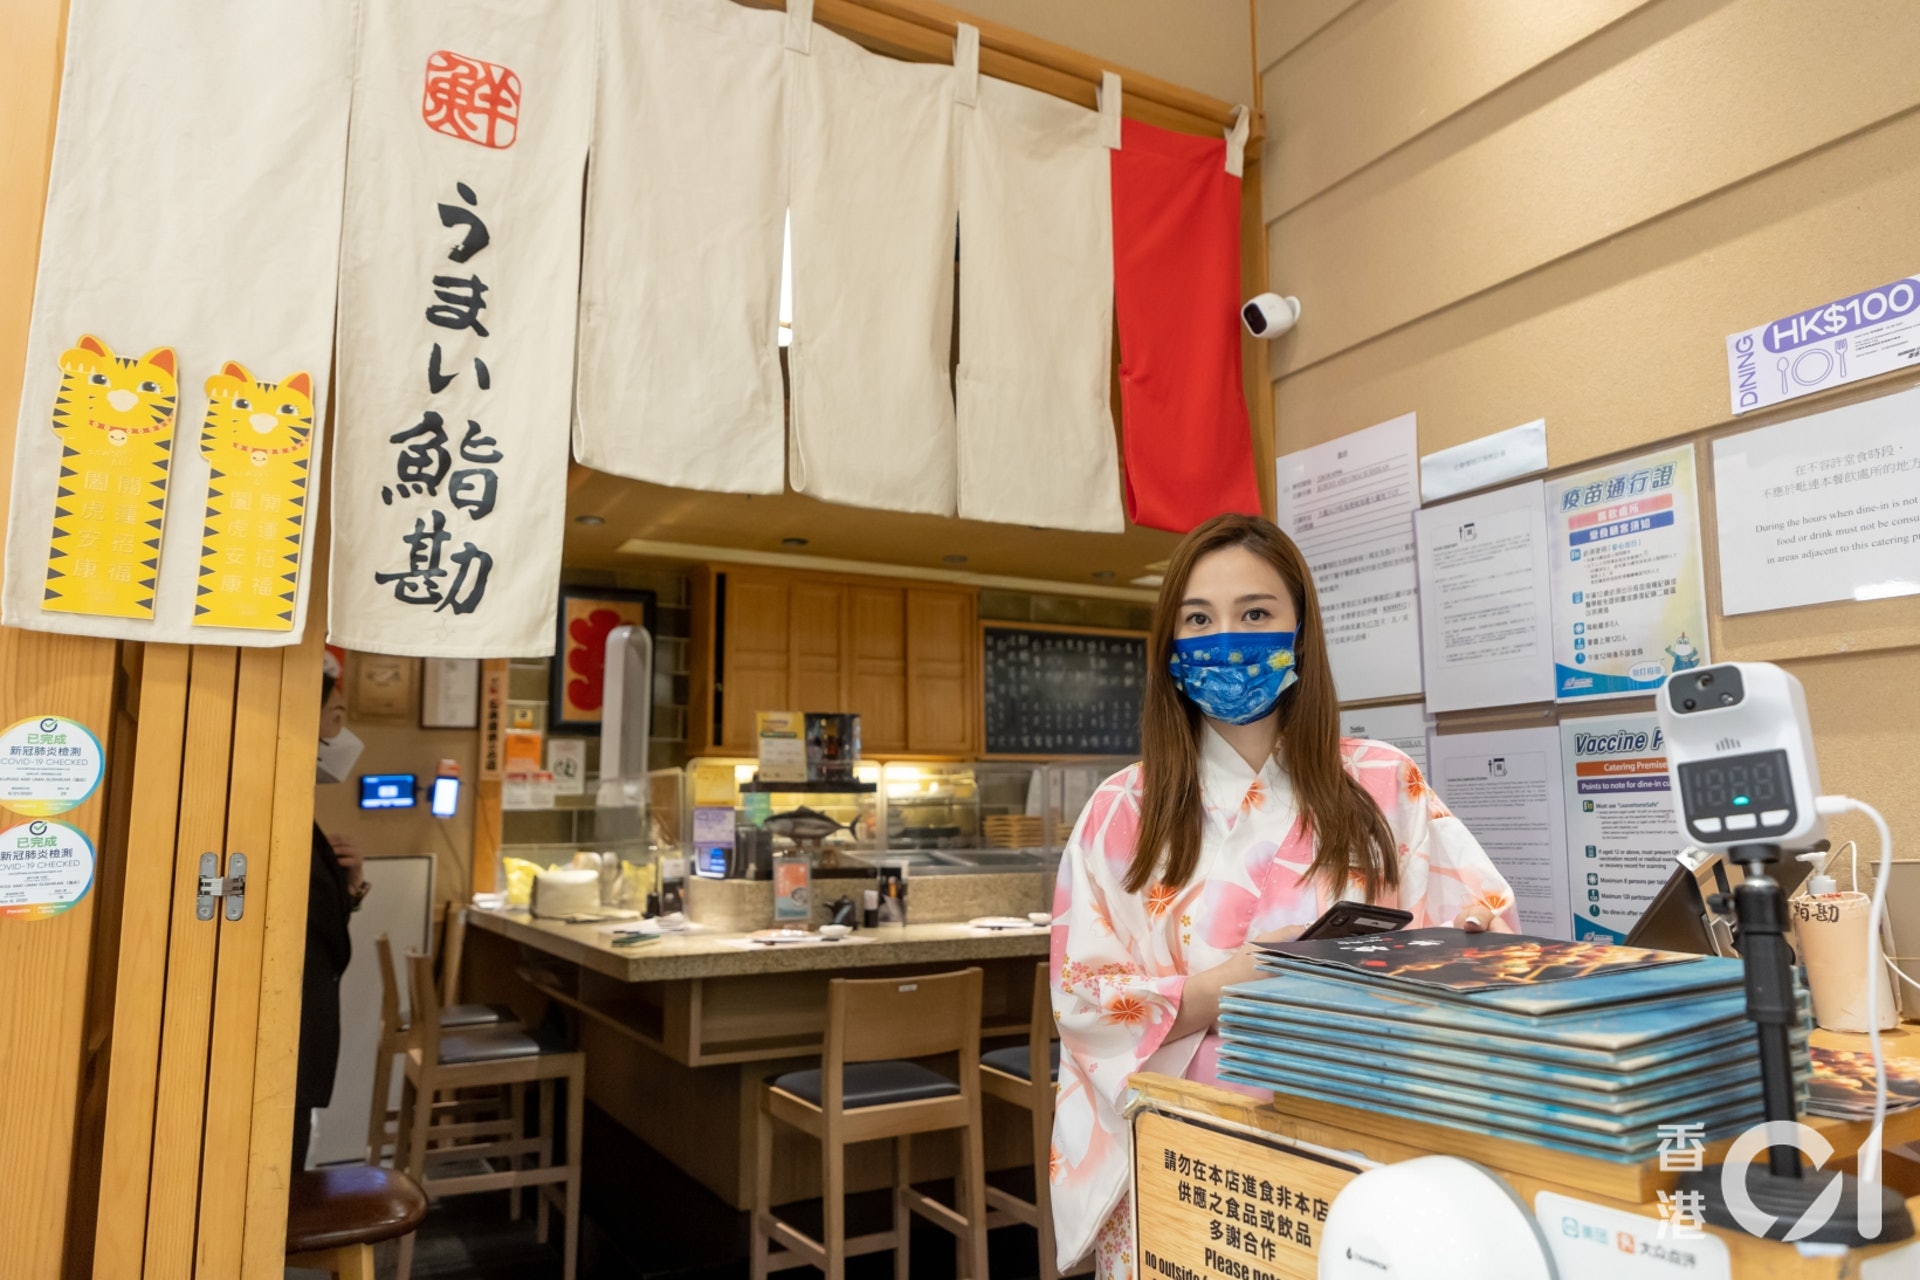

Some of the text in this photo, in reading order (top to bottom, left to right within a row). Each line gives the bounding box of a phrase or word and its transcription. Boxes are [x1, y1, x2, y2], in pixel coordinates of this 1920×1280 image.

[1773, 284, 1914, 350] HK$100
[1735, 334, 1758, 408] DINING
[375, 181, 504, 616] うまい鮨勘
[1561, 463, 1676, 511] 疫苗通行證
[1755, 497, 1918, 533] During the hours when dine-in is not
[1776, 534, 1796, 546] food
[1798, 534, 1808, 542] or
[1810, 529, 1833, 540] drink
[1835, 525, 1858, 535] must
[1860, 522, 1875, 531] not
[1878, 520, 1889, 528] be
[1767, 555, 1775, 564] in
[1777, 553, 1799, 563] areas
[1801, 546, 1838, 559] adjacent
[1851, 541, 1869, 550] this
[1871, 535, 1910, 548] catering
[10, 745, 82, 757] 新冠肺炎檢測
[27, 733, 67, 745] 已完成
[1575, 729, 1647, 756] Vaccine
[0, 758, 44, 766] COVID-19
[1603, 763, 1636, 773] Catering
[1581, 782, 1601, 790] Points
[1602, 782, 1609, 790] to
[1626, 781, 1636, 789] for
[1637, 779, 1662, 788] dine-in
[0, 848, 73, 862] 新冠肺炎檢測
[17, 836, 57, 848] 已完成
[37, 859, 81, 869] CHECKED
[1163, 1148, 1329, 1223] 請勿在本店進食非本店
[1178, 1180, 1312, 1248] 供應之食品或飲品
[1209, 1218, 1277, 1263] 多謝合作
[1145, 1250, 1157, 1270] no
[1205, 1247, 1249, 1280] Please
